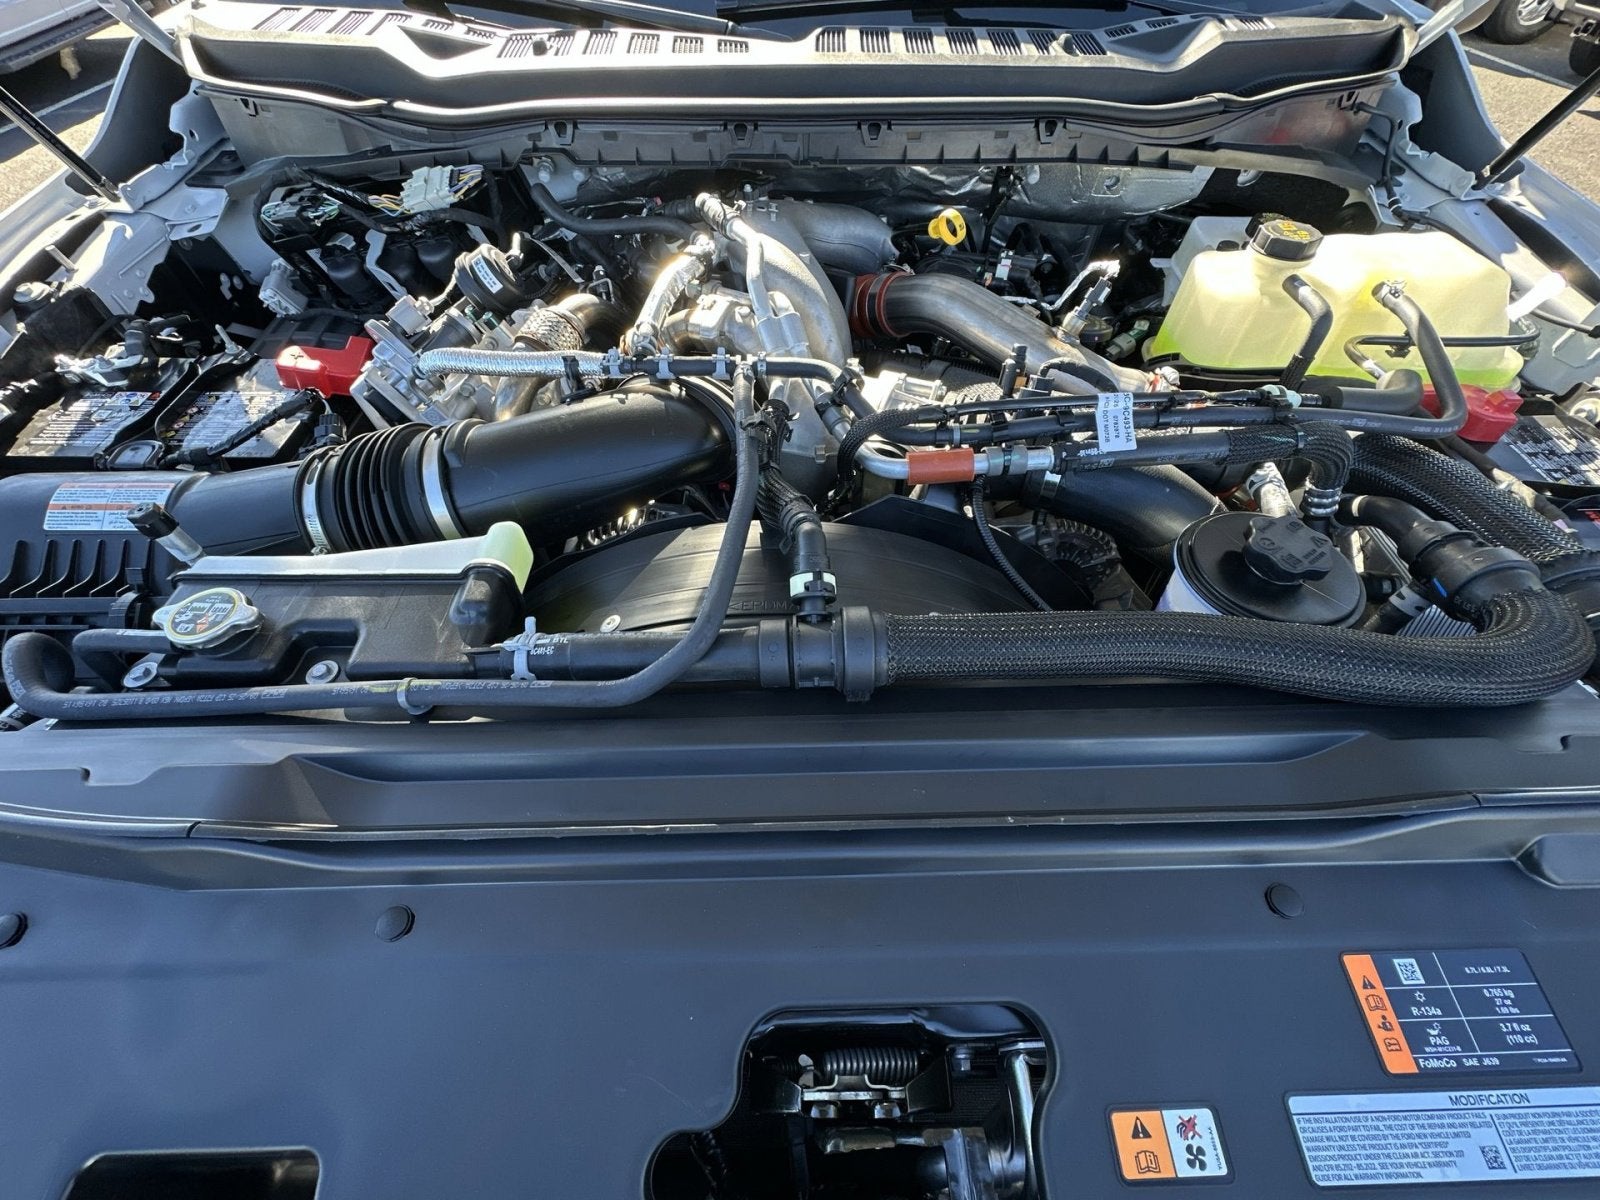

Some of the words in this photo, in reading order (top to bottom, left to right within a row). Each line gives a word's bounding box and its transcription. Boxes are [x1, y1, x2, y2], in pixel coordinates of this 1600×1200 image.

[1505, 988, 1515, 998] kg
[1411, 1006, 1442, 1016] R-134a
[1499, 1023, 1514, 1032] 3.7
[1514, 1023, 1522, 1032] fl
[1522, 1024, 1532, 1032] oz
[1429, 1036, 1450, 1046] PAG
[1506, 1035, 1524, 1045] (110
[1524, 1034, 1538, 1044] cc)
[1419, 1058, 1458, 1068] FoMoCo
[1462, 1058, 1480, 1066] SAE
[1448, 1093, 1531, 1106] MODIFICATION
